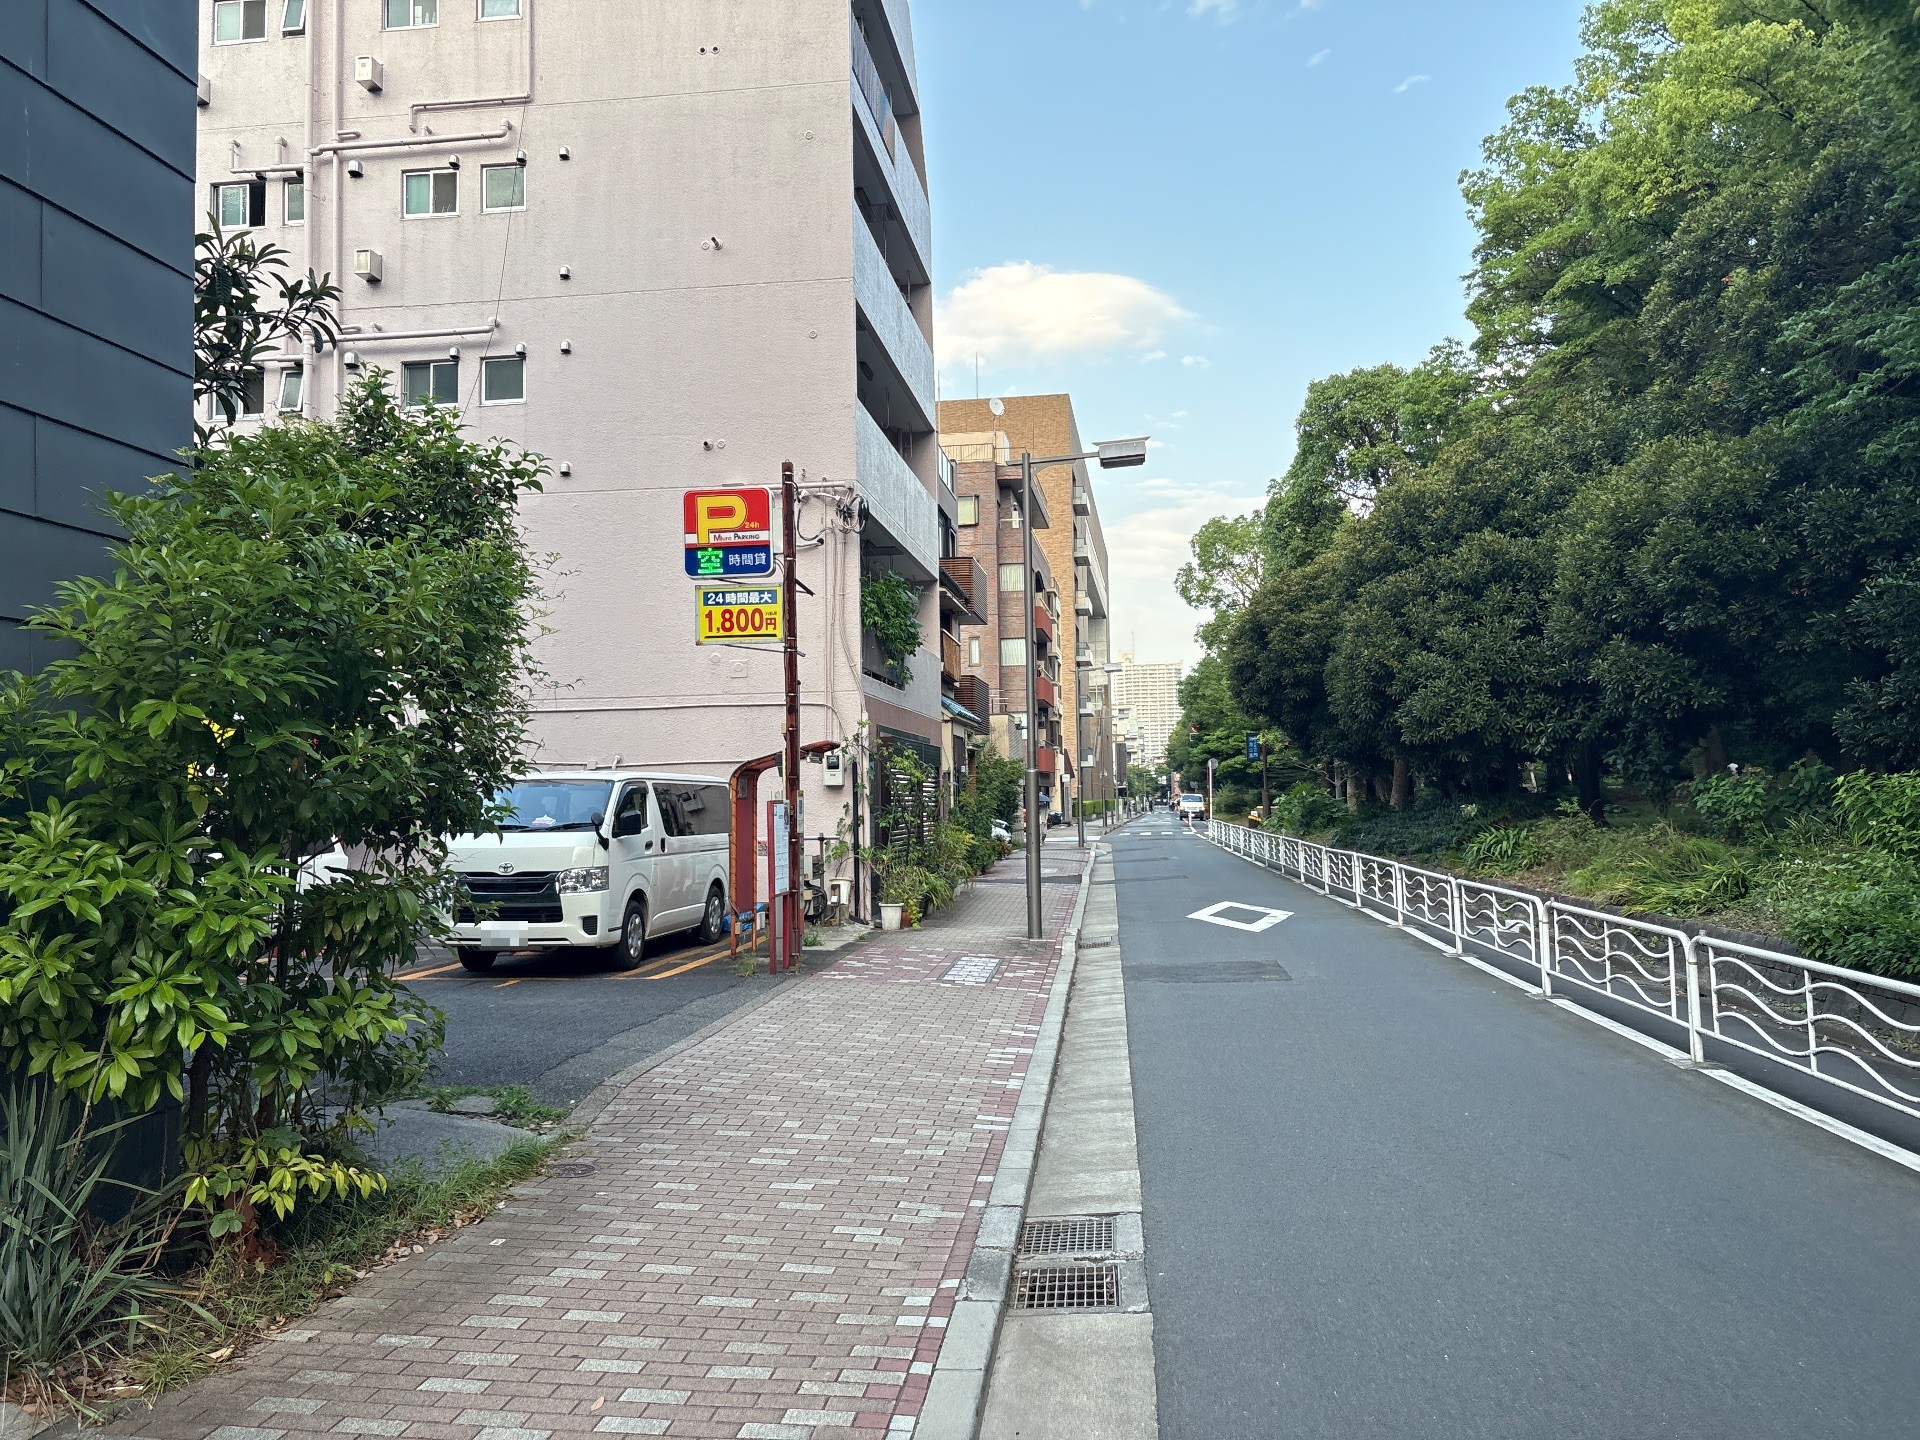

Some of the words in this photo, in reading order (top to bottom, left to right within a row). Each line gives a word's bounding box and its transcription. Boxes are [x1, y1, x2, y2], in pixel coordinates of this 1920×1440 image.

[696, 495, 747, 545] P
[744, 521, 760, 529] 24h
[697, 547, 723, 574] 空
[728, 552, 767, 567] 時間貸
[707, 591, 772, 605] 24時間最大
[705, 607, 777, 633] 1,800円
